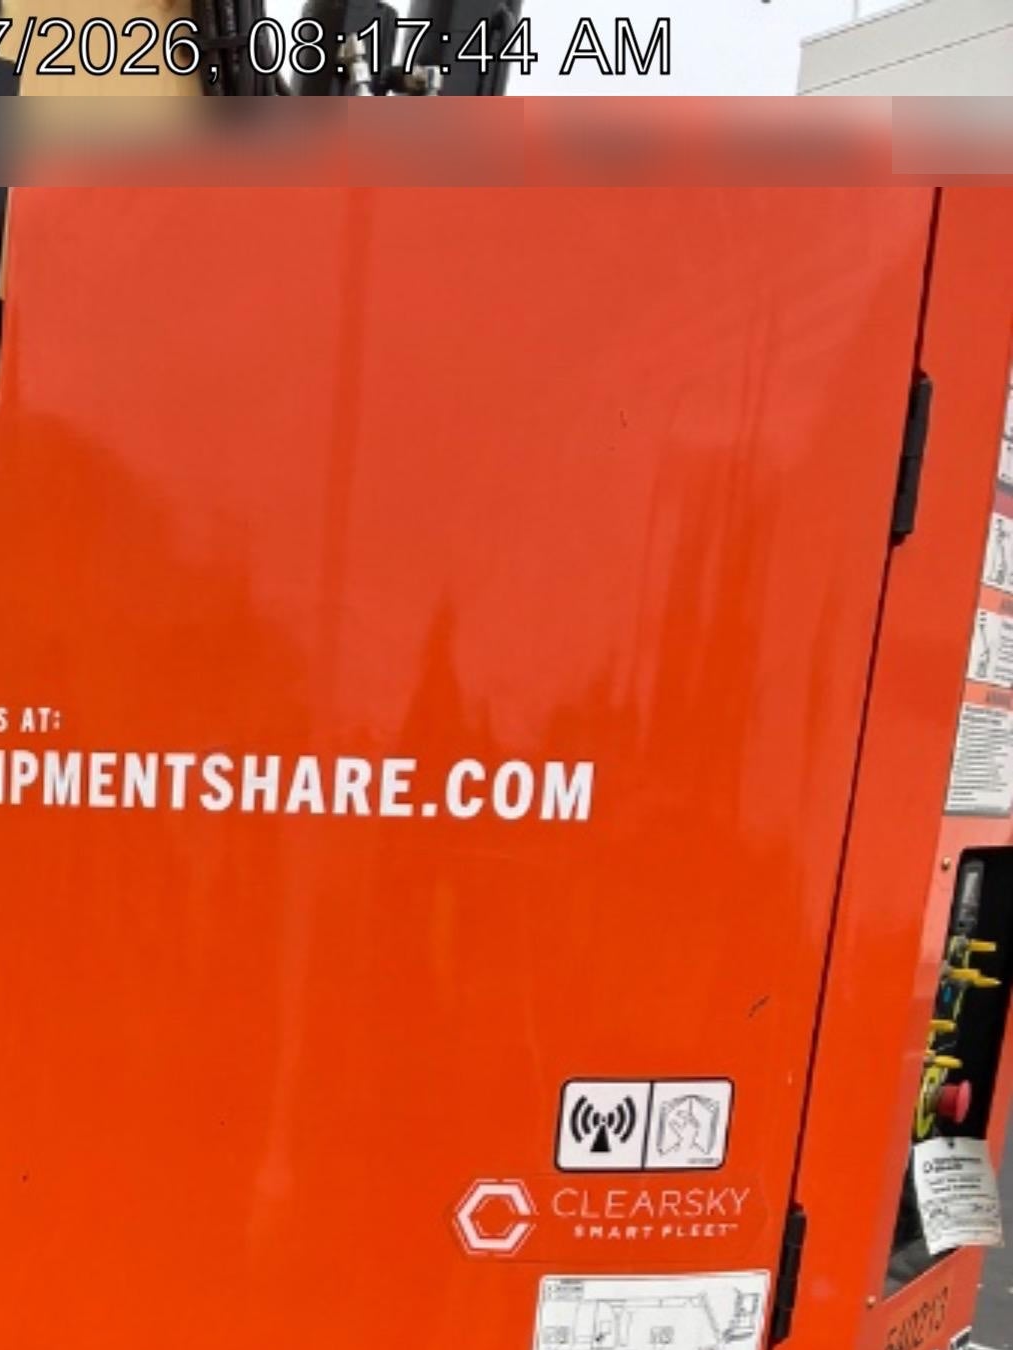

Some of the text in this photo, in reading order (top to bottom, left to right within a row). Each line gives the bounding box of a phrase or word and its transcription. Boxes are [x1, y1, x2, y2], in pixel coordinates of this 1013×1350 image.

[21, 709, 61, 734] AT:
[552, 1186, 751, 1219] CLEARSKY
[574, 1224, 653, 1240] SMART
